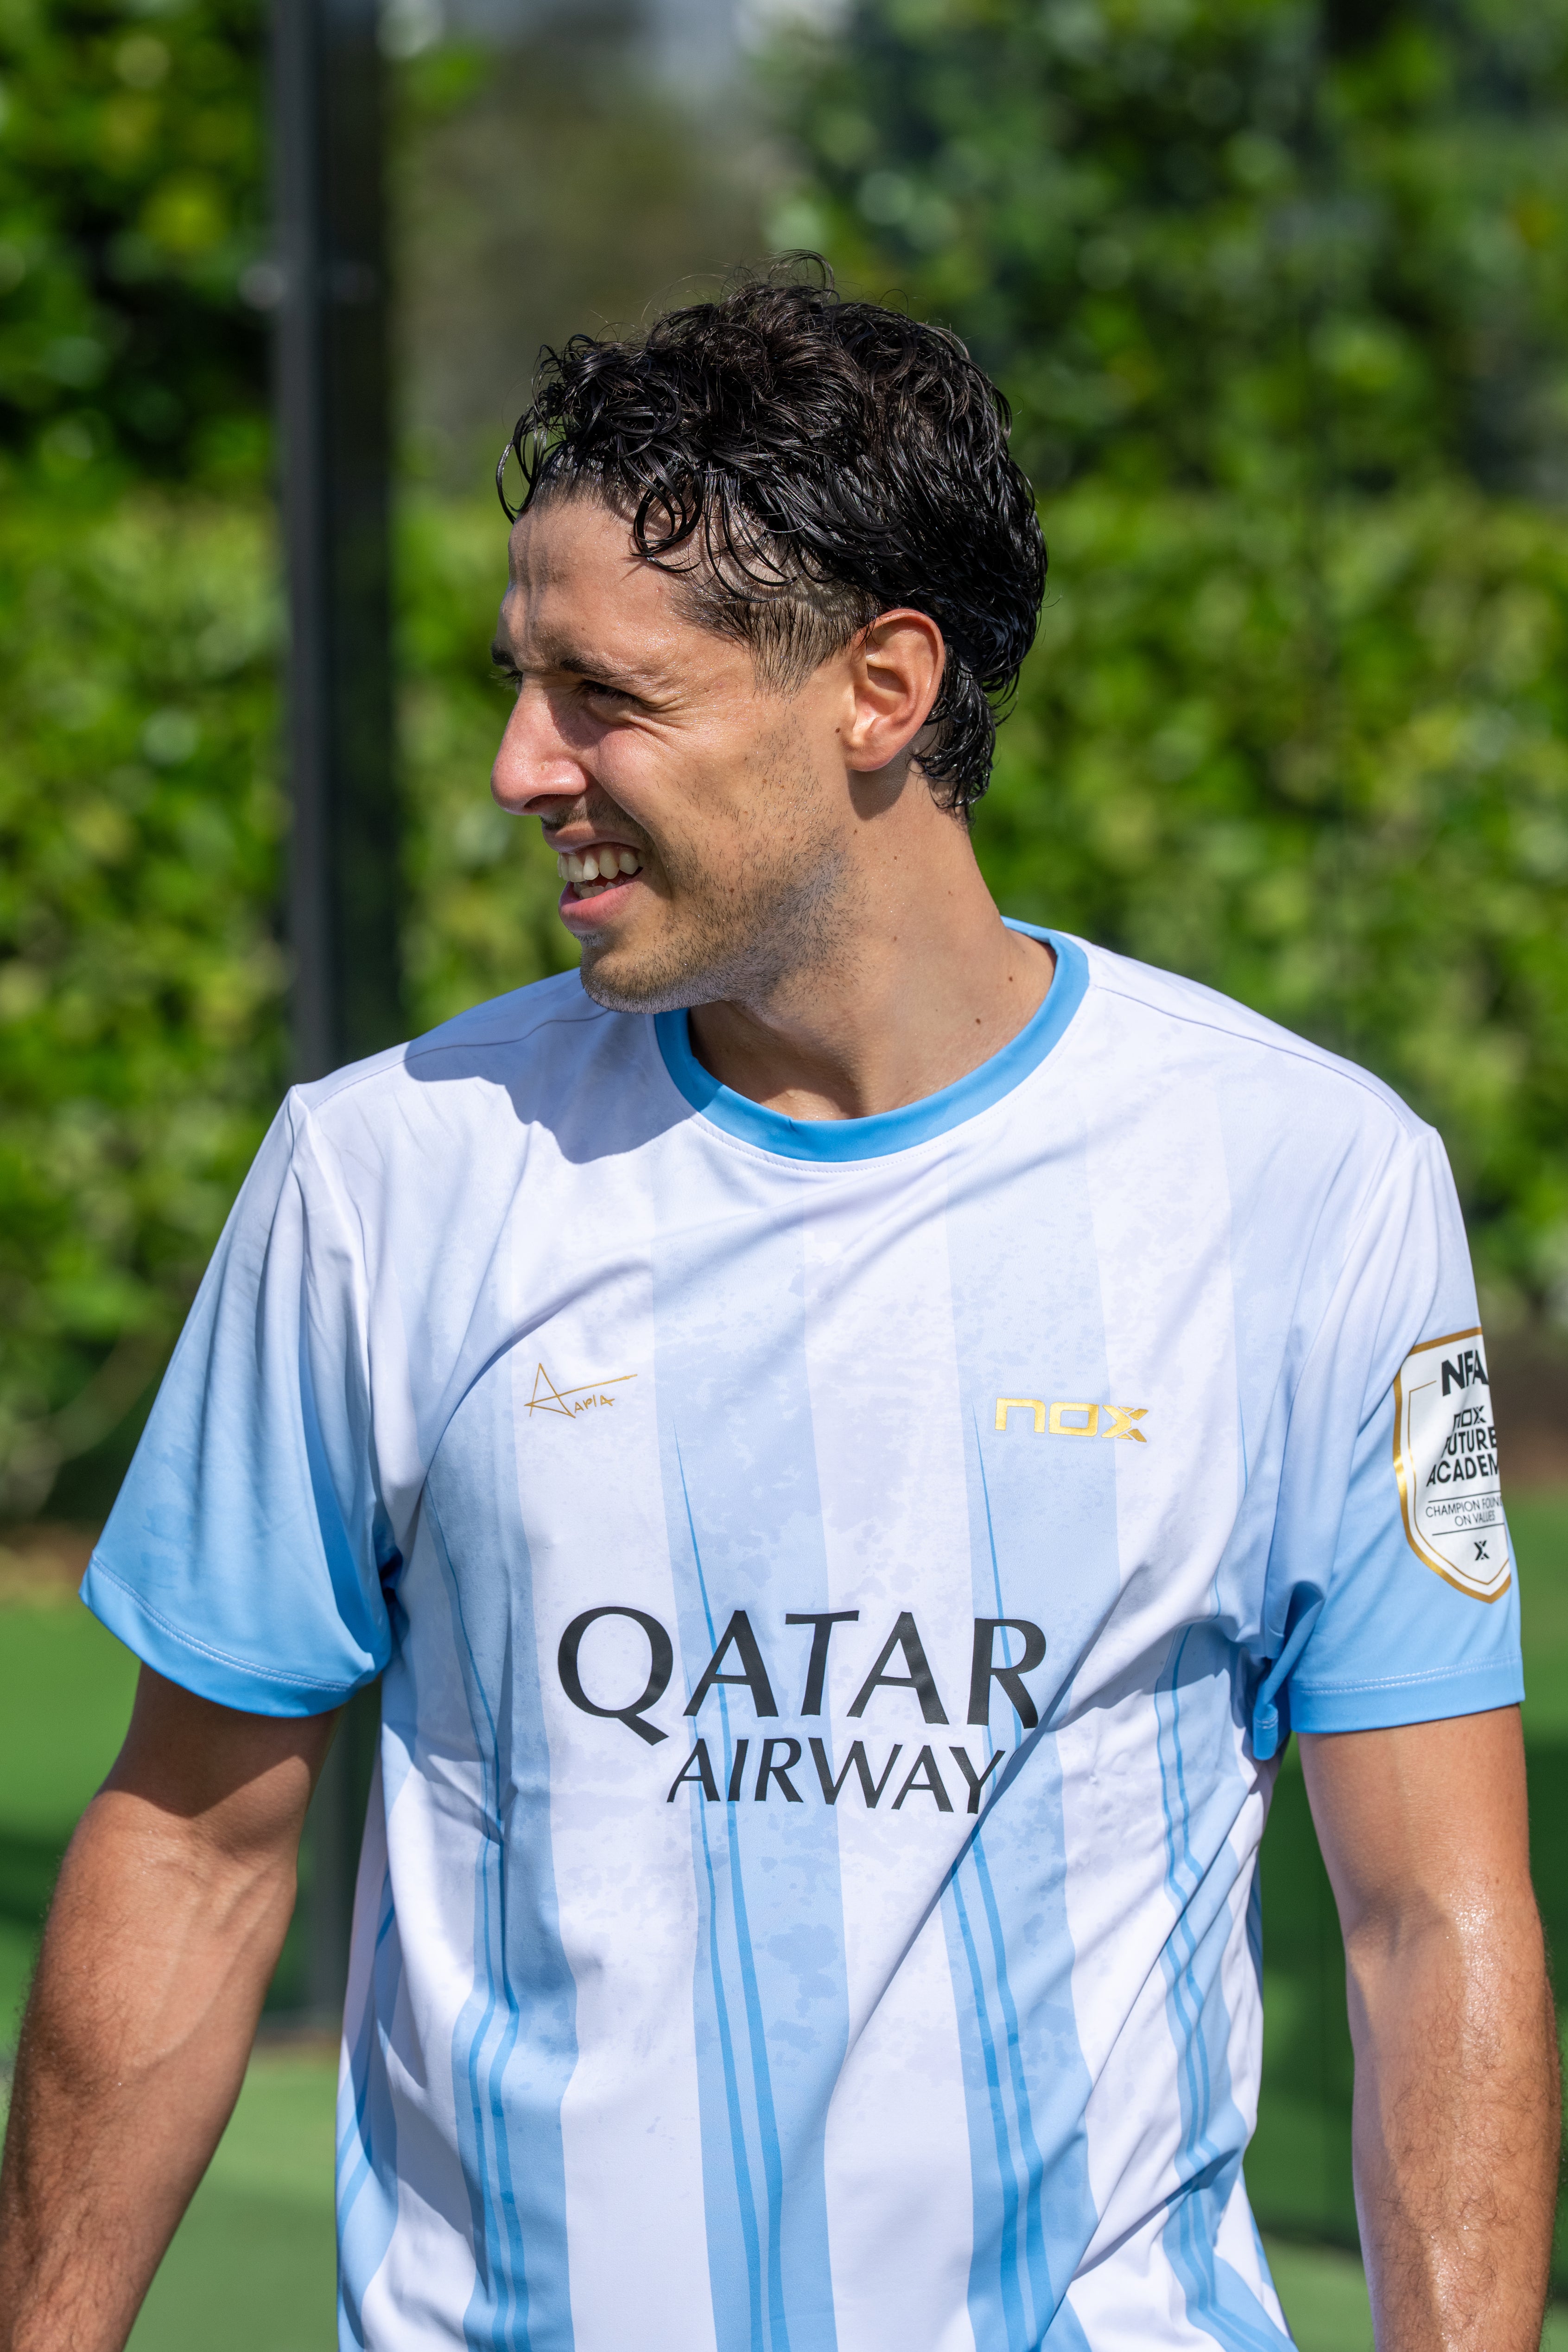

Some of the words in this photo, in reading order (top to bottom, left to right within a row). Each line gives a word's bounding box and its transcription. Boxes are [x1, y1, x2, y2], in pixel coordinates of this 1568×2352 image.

[1441, 1349, 1490, 1397] NFA
[995, 1397, 1149, 1443] nox
[1425, 1500, 1480, 1518] CHAMPION
[1482, 1496, 1503, 1509] FOUN
[1454, 1515, 1472, 1527] ON
[1473, 1510, 1496, 1524] VALUES
[558, 1606, 1047, 1746] QATAR
[666, 1736, 1006, 1815] AIRWAY
